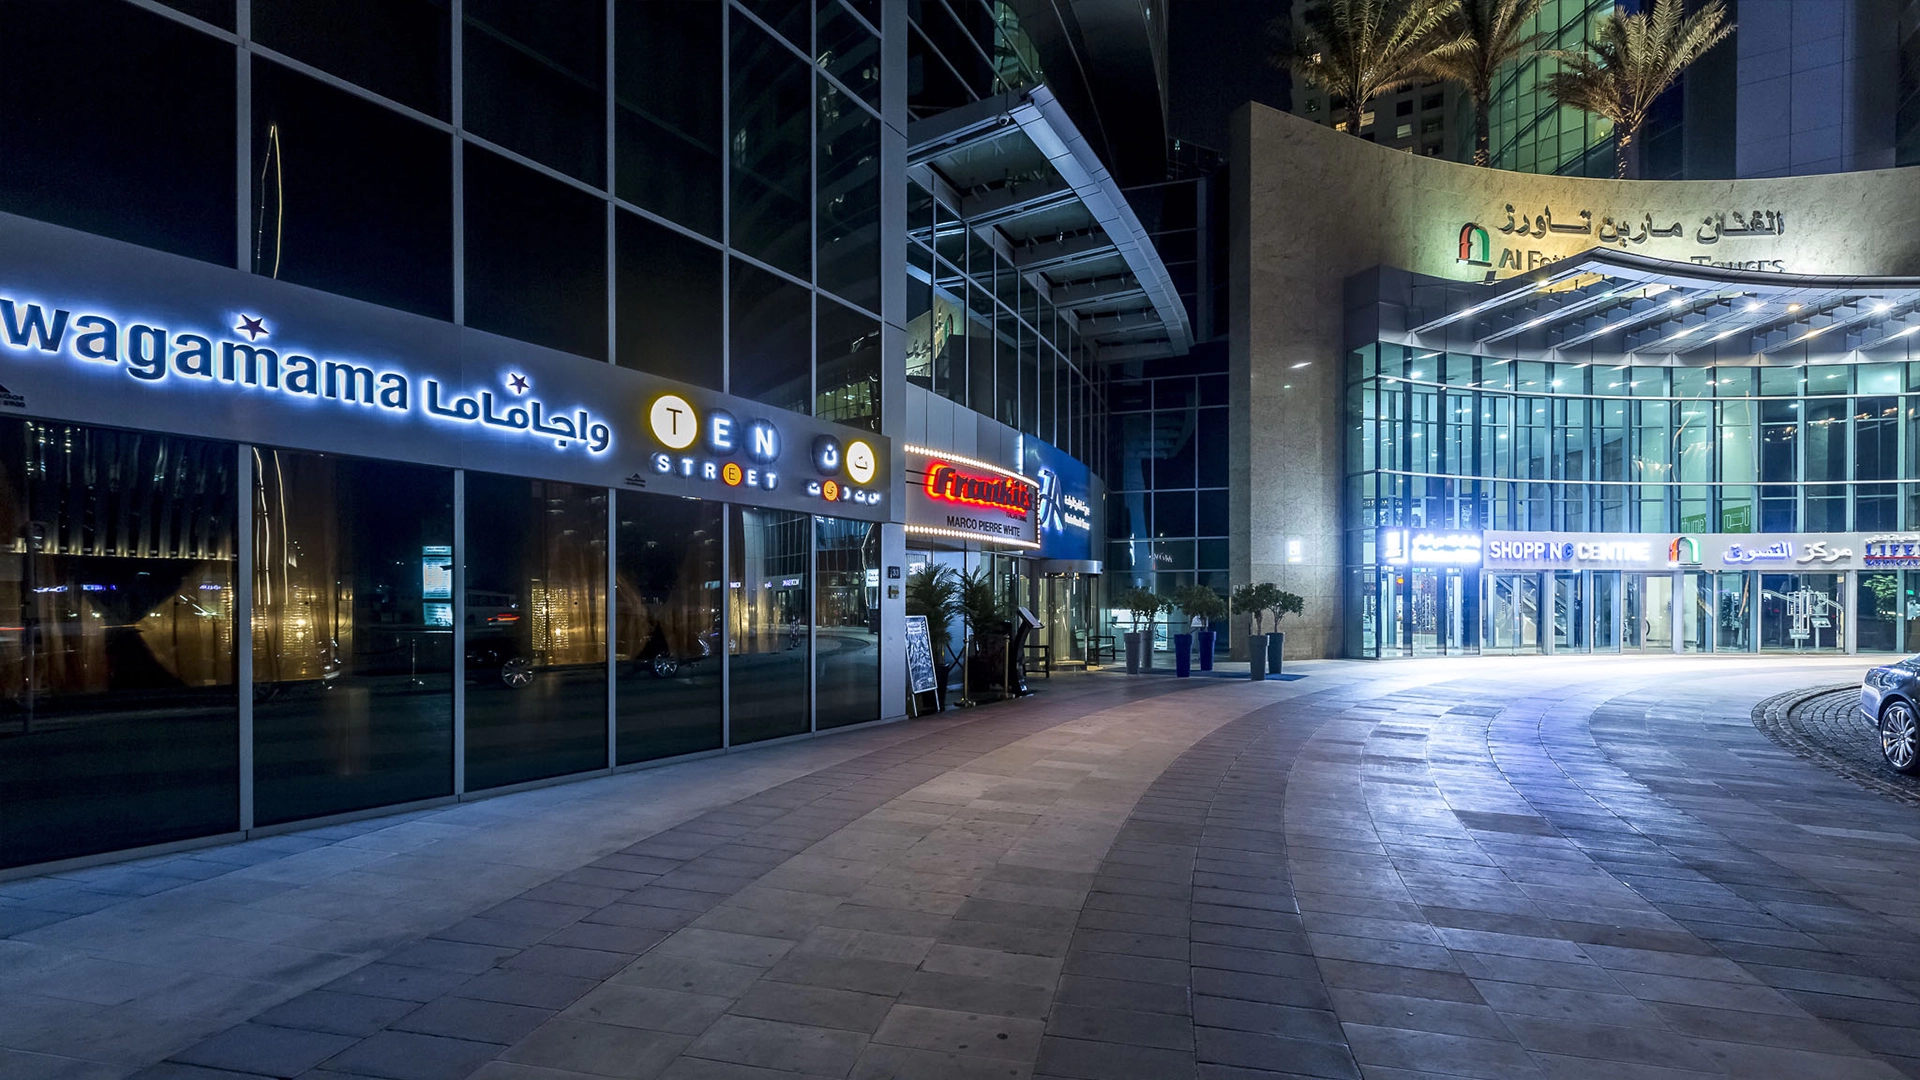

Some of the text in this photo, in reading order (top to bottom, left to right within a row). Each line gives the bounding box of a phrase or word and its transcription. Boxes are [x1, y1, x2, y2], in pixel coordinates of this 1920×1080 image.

[1497, 203, 1592, 239] تاورز
[1600, 212, 1683, 248] مارين
[1498, 247, 1522, 270] Al
[1, 300, 409, 411] wagamama
[426, 379, 611, 453] واجاماما
[665, 407, 774, 456] TEN
[657, 454, 777, 489] STREET
[946, 515, 1021, 538] MARCO PIERRE WHITE
[1489, 541, 1574, 560] SHOPPING
[1577, 541, 1650, 561] CENTRE
[1723, 541, 1853, 563] مركز التسوق
